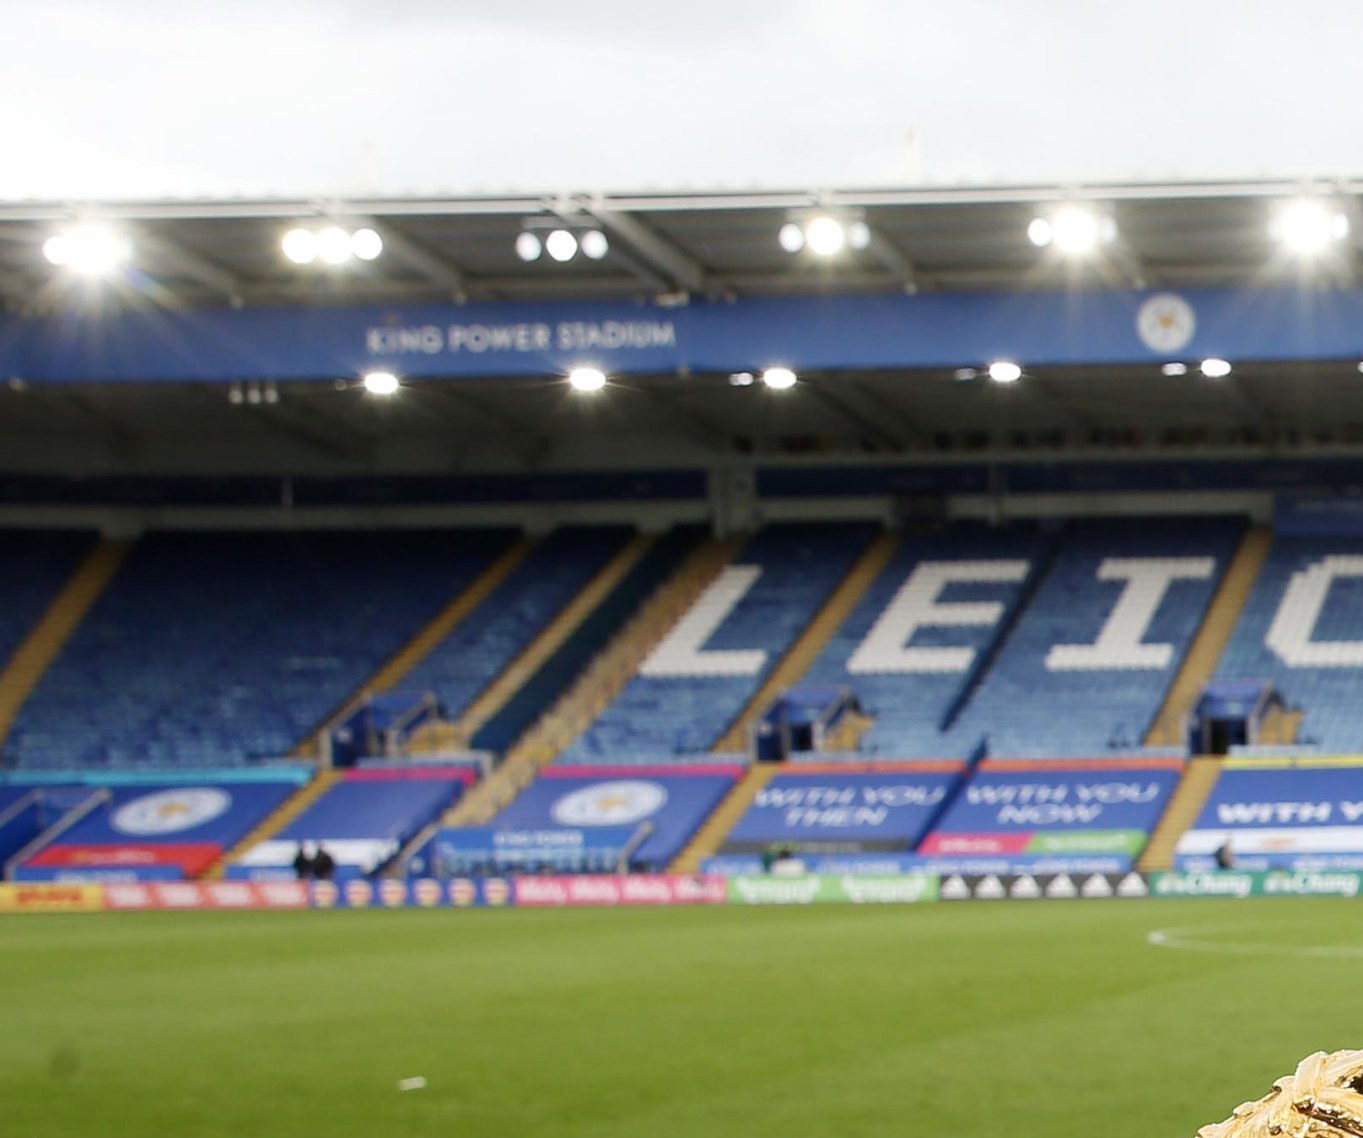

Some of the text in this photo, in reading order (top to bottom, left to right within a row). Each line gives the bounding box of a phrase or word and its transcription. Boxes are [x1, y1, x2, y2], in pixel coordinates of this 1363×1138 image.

[366, 321, 675, 354] KING POWER STADIUM
[755, 785, 946, 808] WITH YOU
[967, 783, 1160, 806] WITH YOU
[785, 804, 888, 827] THEN
[997, 803, 1102, 826] NOW
[1217, 801, 1332, 824] WITH
